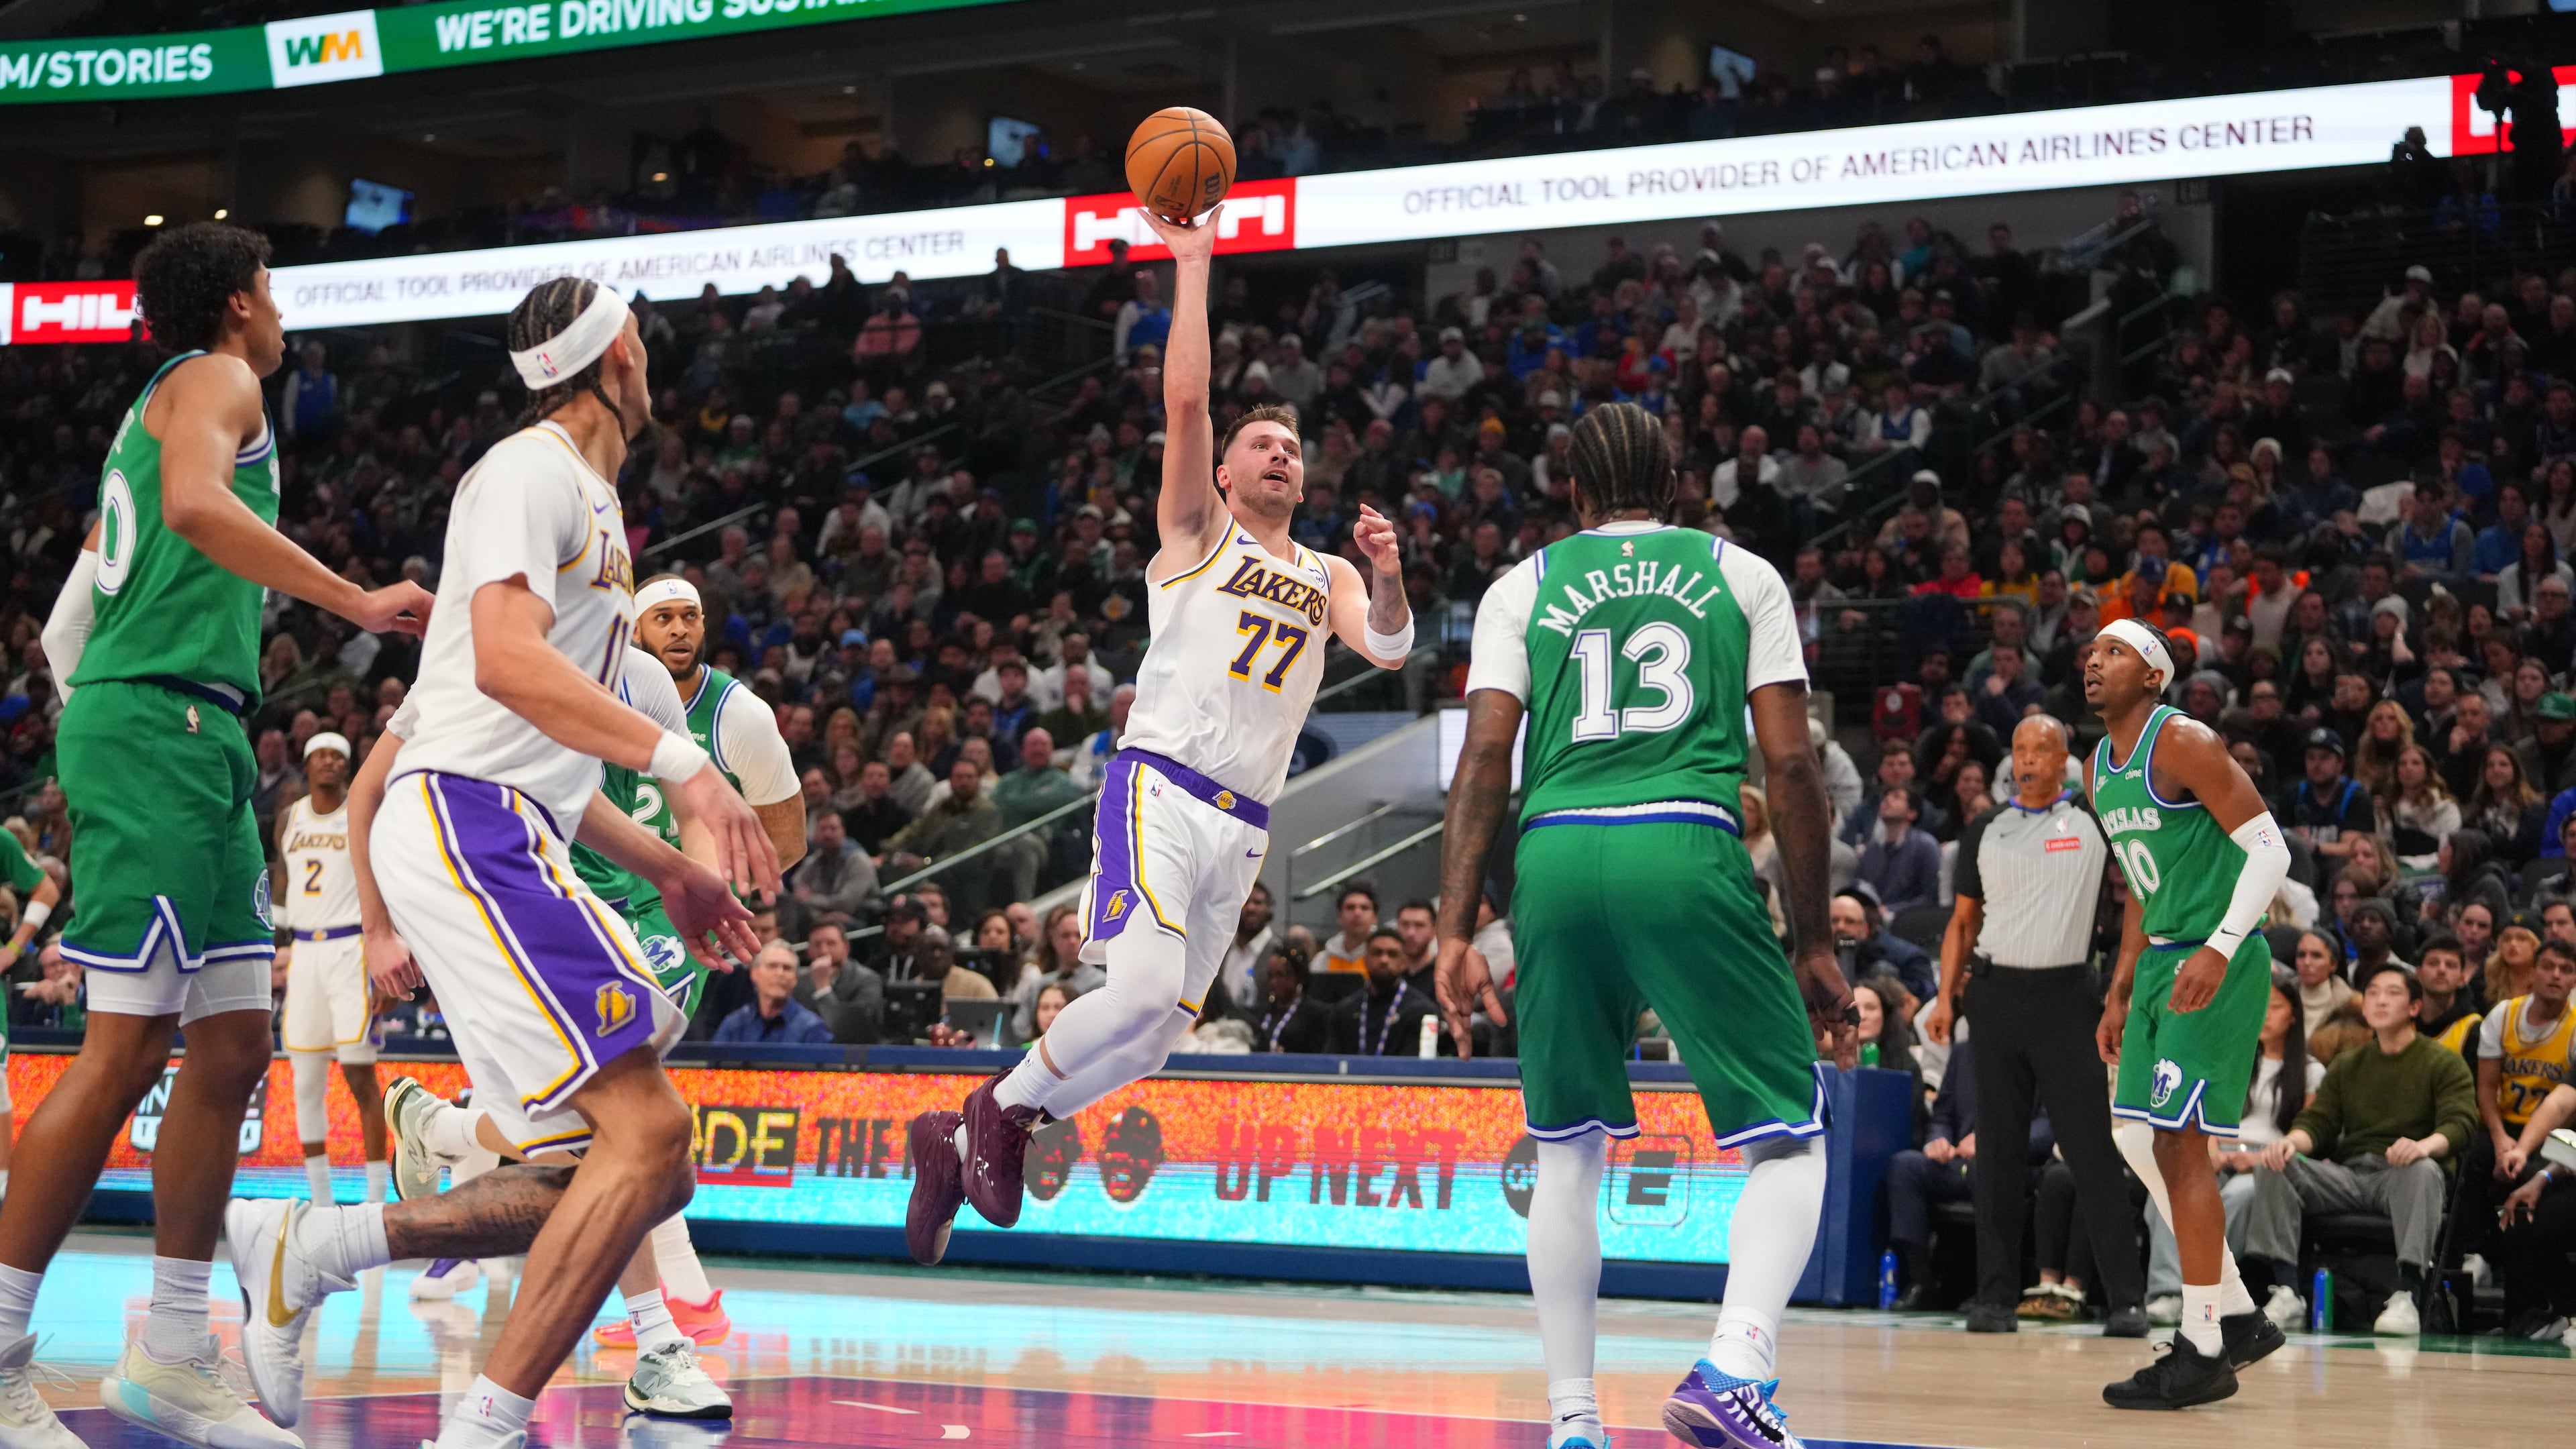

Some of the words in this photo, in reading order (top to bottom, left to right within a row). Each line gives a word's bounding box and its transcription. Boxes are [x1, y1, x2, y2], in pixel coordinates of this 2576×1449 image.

[284, 30, 362, 66] WM
[559, 0, 713, 39] DRIVING
[1404, 182, 1529, 214] OFFICIAL
[1541, 175, 1615, 202] TOOL
[1628, 160, 1779, 195] PROVIDER
[1791, 155, 1830, 182] OF
[1840, 141, 2006, 177] AMERICAN
[2019, 126, 2166, 163] AIRLINES
[2179, 115, 2313, 150] CENTER
[295, 280, 385, 307] OFFICIAL
[398, 274, 451, 301] TOOL
[582, 260, 612, 281] OF
[618, 250, 739, 280] AMERICAN
[866, 230, 964, 260] CENTER
[22, 293, 142, 331] HIL
[1215, 553, 1327, 628] LAKERS
[1538, 561, 1721, 637] MARSHALL
[1228, 609, 1309, 694] 77
[1568, 621, 1694, 743] 13
[304, 858, 323, 896] 2
[2111, 839, 2160, 900] 10
[2504, 1057, 2563, 1082] AKERS
[816, 1118, 893, 1179] THE
[1216, 1123, 1295, 1202] UP
[1309, 1124, 1467, 1210] NEXT
